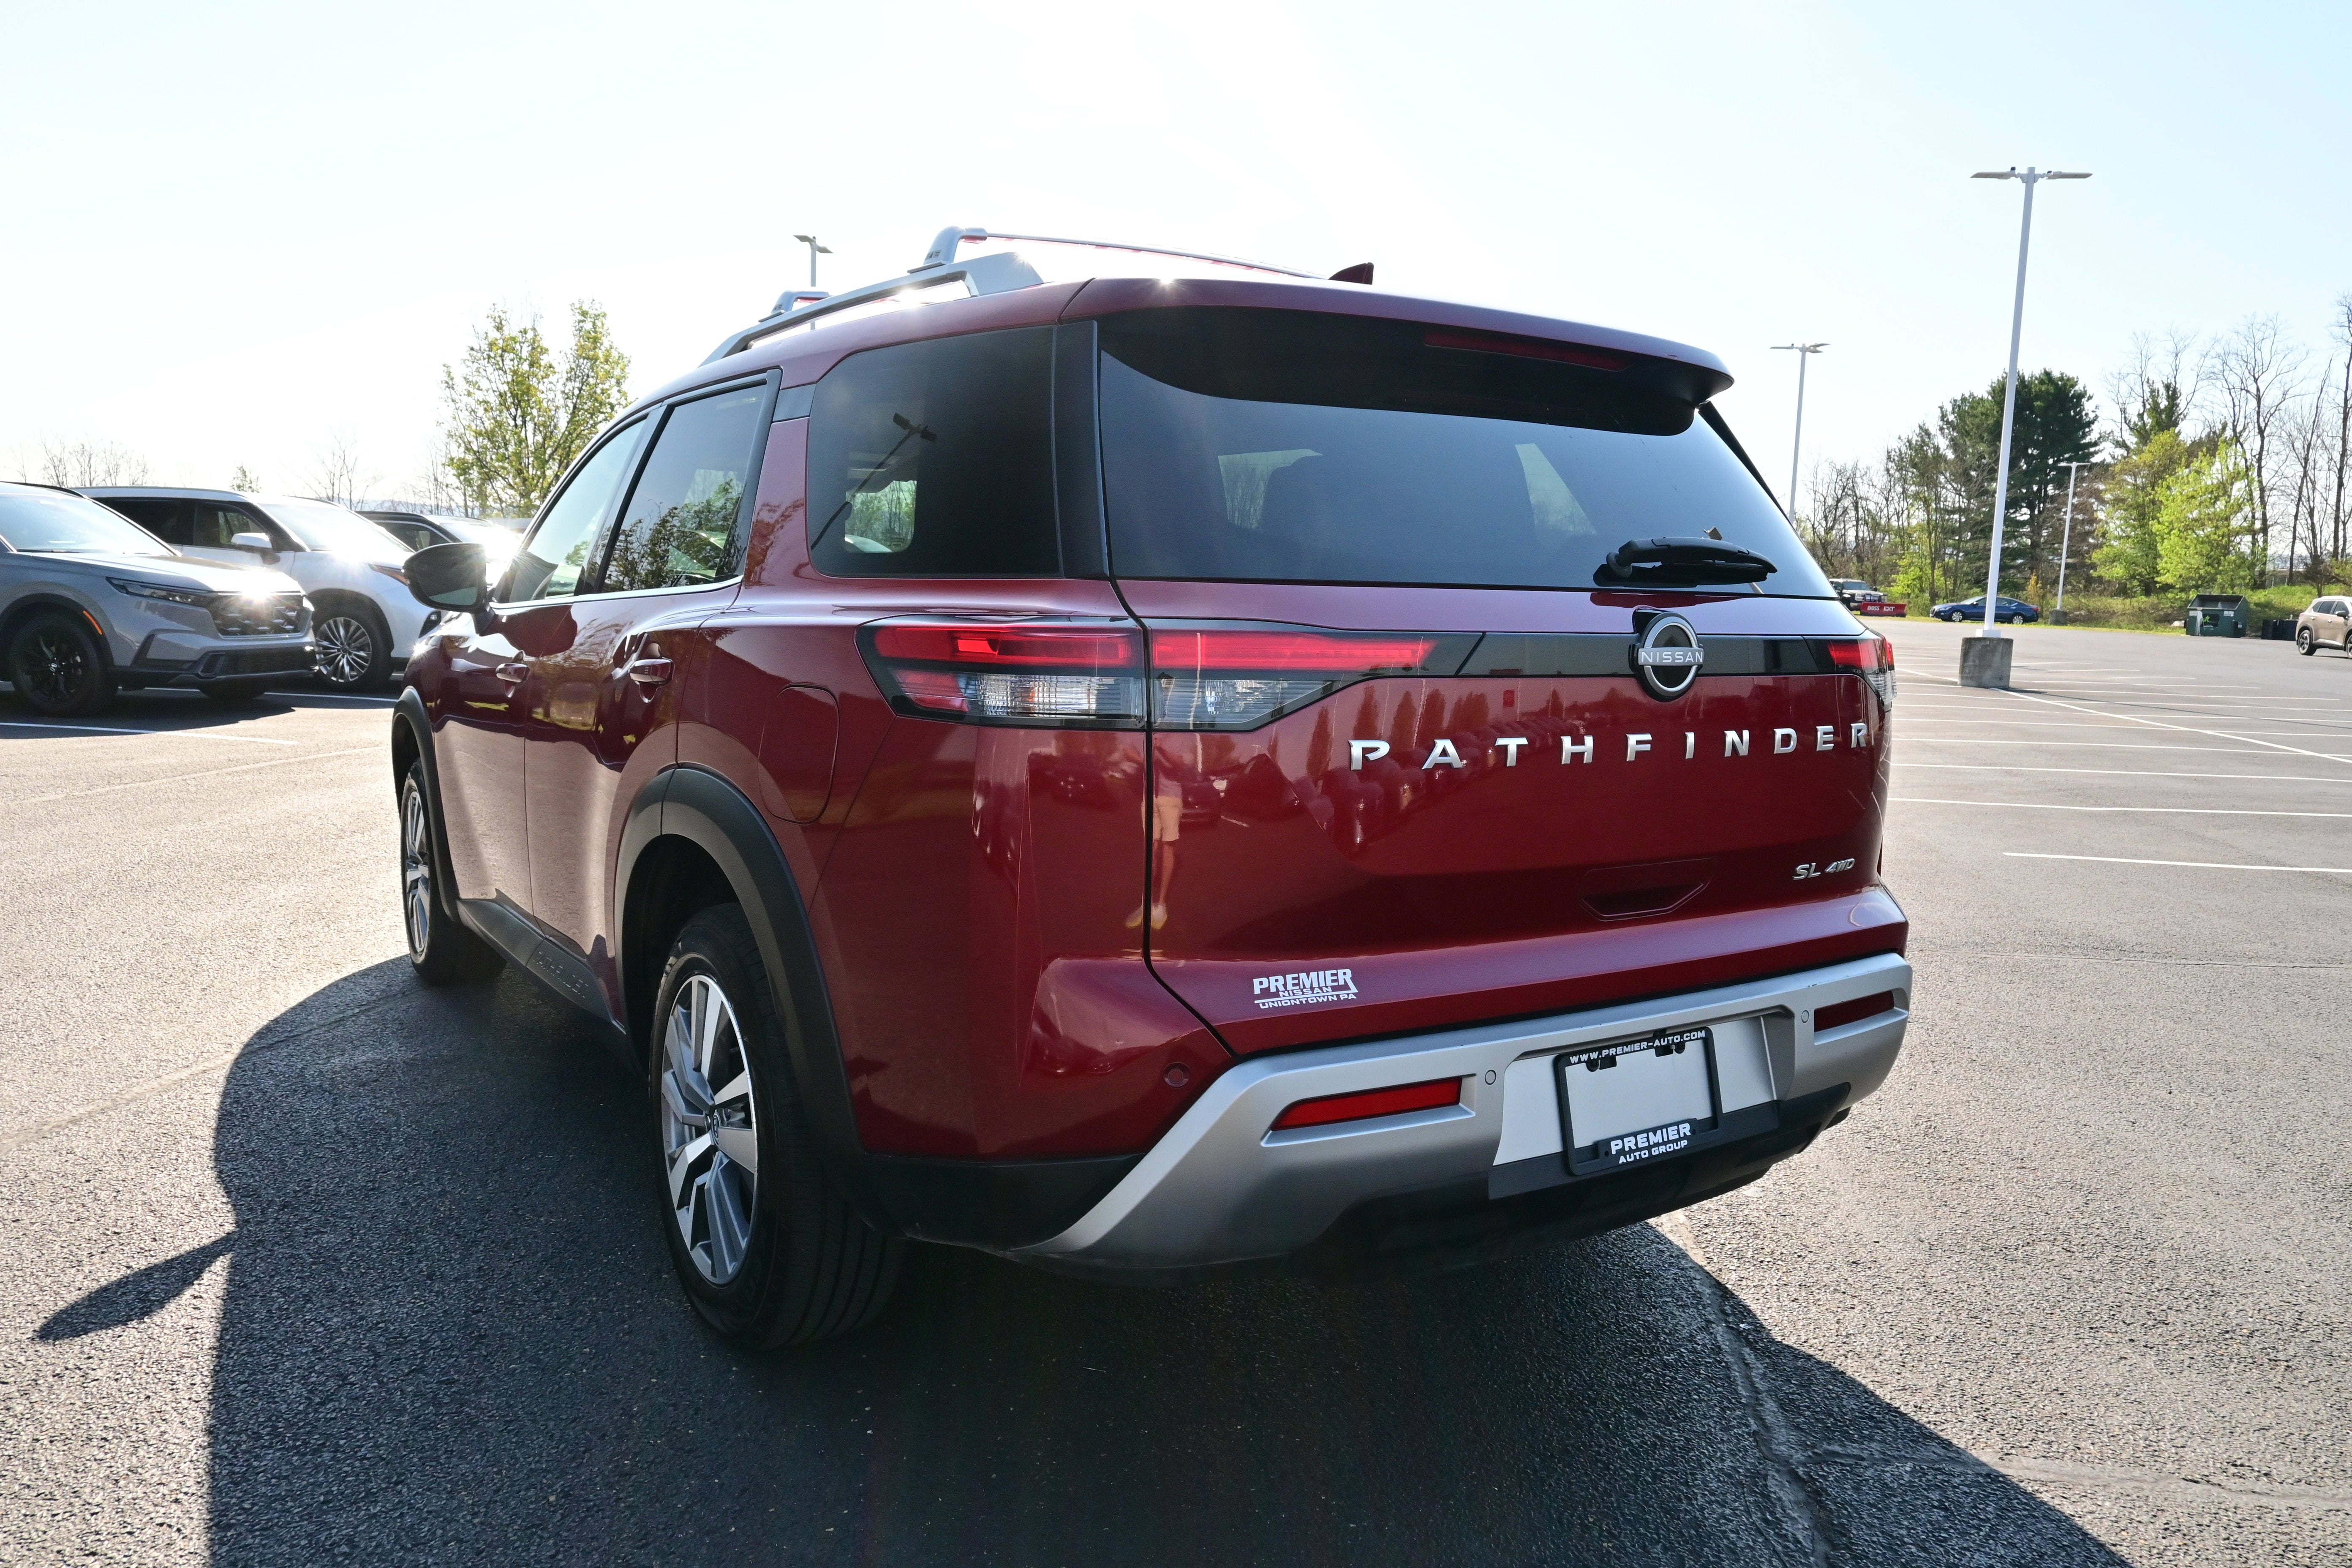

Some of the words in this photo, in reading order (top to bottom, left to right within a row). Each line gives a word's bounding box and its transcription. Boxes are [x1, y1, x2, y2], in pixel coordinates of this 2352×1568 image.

[1642, 651, 1703, 662] NISSAN
[1348, 722, 1869, 770] PATHFINDER
[1792, 863, 1821, 880] SL
[1824, 858, 1855, 873] 4WD
[1253, 969, 1358, 994] PREMIER
[1279, 986, 1332, 997] NISSAN
[1259, 994, 1337, 1009] UNIONTOWN
[1570, 1030, 1706, 1064] WWW.PREMIER-AUTO.COM
[1610, 1123, 1691, 1155] PREMIER
[1619, 1150, 1649, 1164] AUTO
[1652, 1140, 1688, 1155] GROUP
